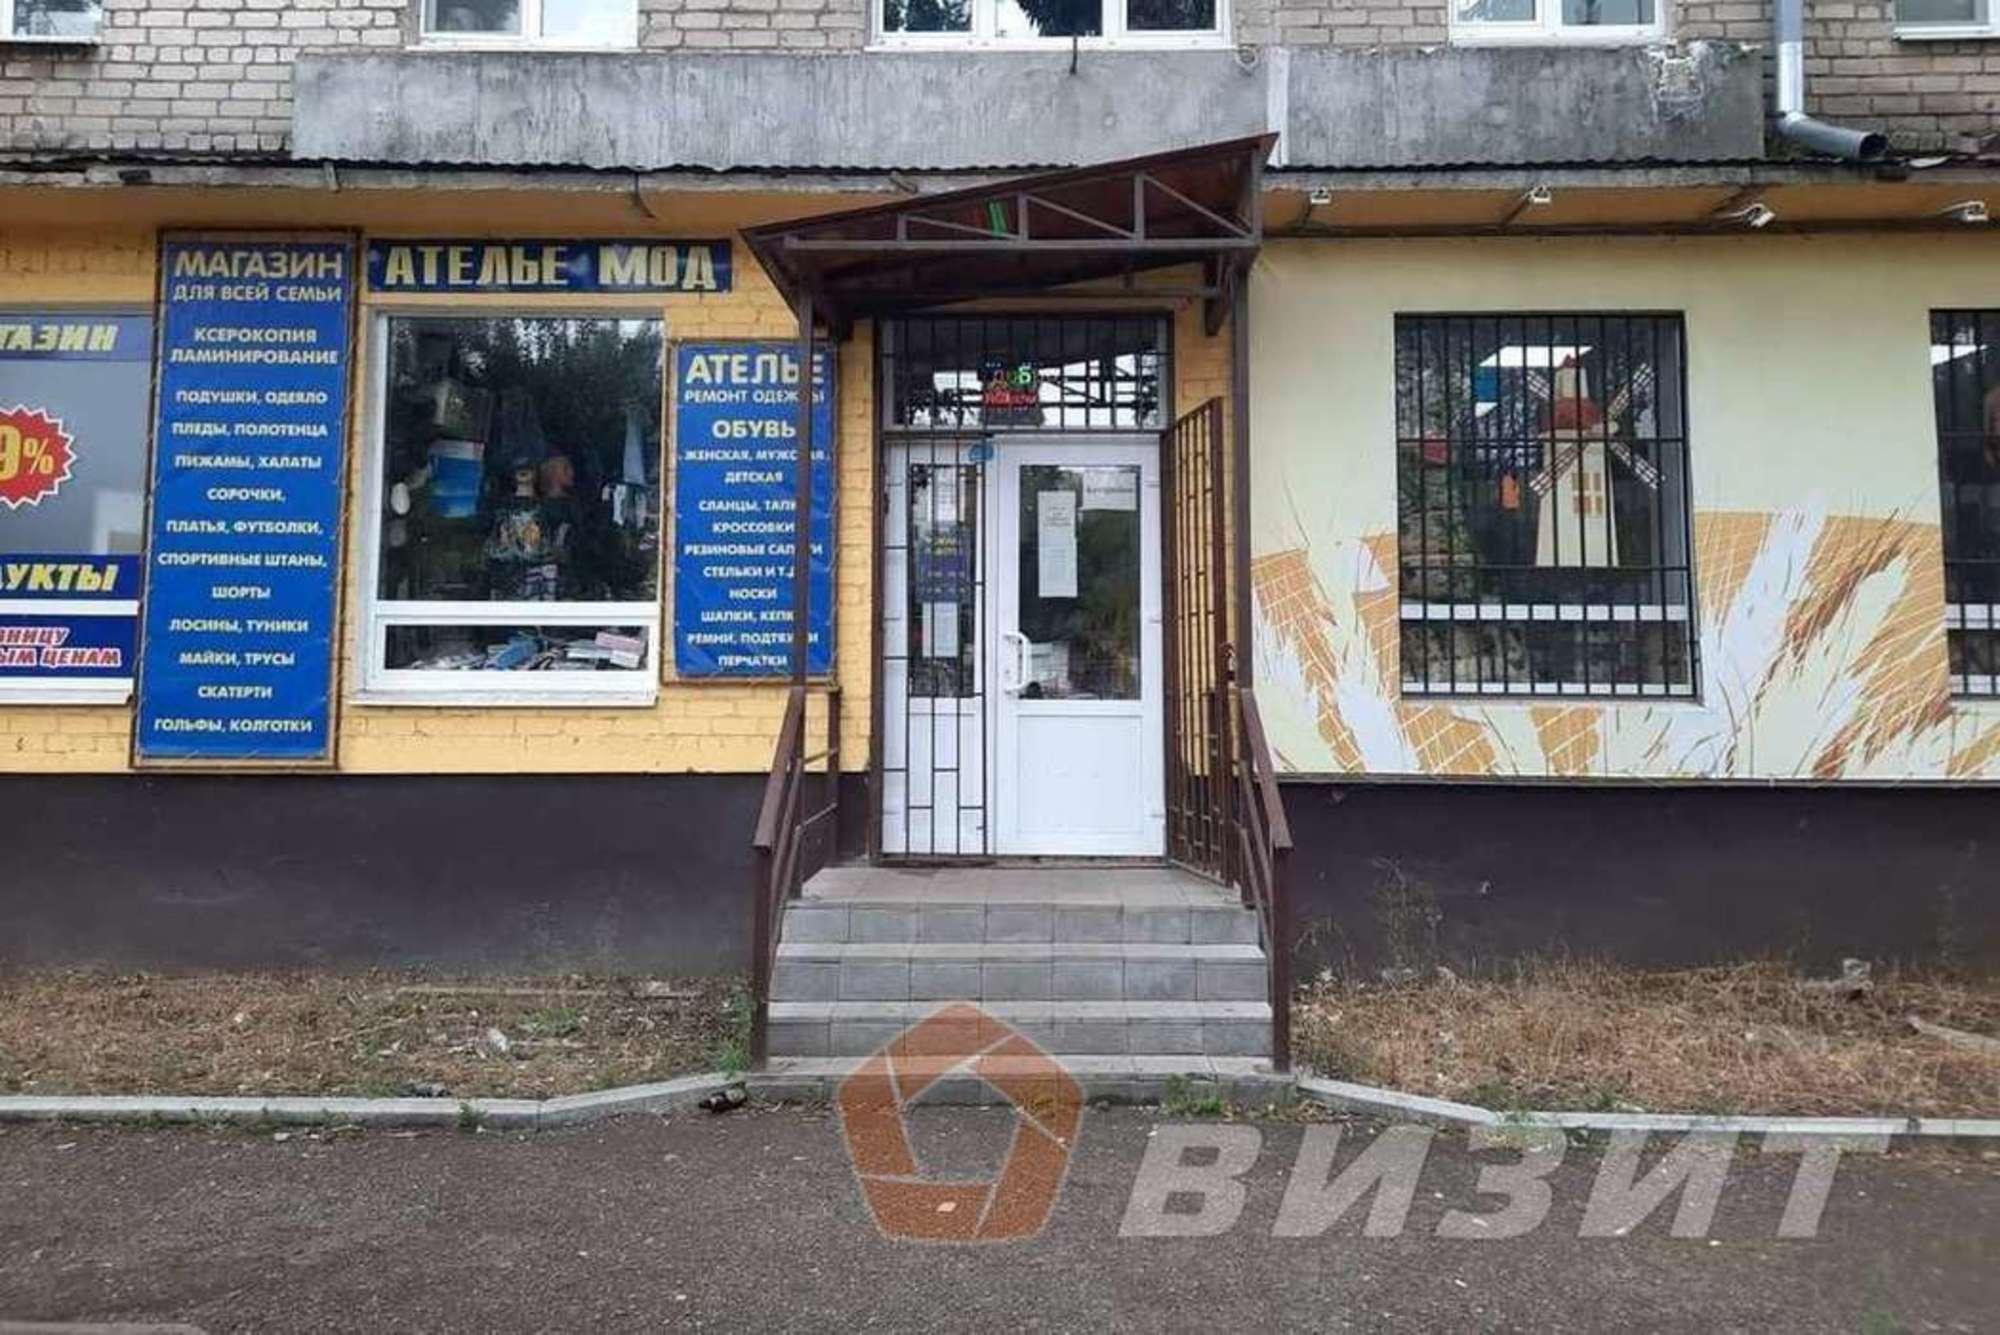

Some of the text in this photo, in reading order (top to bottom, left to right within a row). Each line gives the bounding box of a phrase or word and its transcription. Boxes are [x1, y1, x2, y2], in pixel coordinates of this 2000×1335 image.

[175, 252, 342, 279] МАГАЗИН
[385, 246, 717, 290] АТЕЛЬЕ МОД
[173, 283, 342, 303] ДЛЯ ВСЕЙ СЕМЬИ
[194, 328, 317, 343] КСЕРОКОПИЯ
[170, 349, 338, 365] ЛАМИНИРОВАНИЕ
[686, 354, 824, 384] АТЕЛЬЕ
[176, 390, 328, 405] ПОДУШКИ, ОДЕЯЛО
[684, 390, 825, 405] РЕМОНТ ОДЕЖЫ
[235, 423, 328, 437] ПОЛОТЕНЦА
[712, 420, 797, 438] ОБУВЬ
[174, 456, 322, 470] ПИЖАМЫ, ХАЛАТЫ
[724, 471, 784, 484] ДЕТСКАЯ
[207, 488, 286, 502] СОРОЧКИ,
[166, 521, 323, 535] ПЛАТЬЯ, ФУТБОЛКИ,
[684, 544, 765, 556] РЕЗИНОВЫЕ
[158, 552, 327, 568] СПОРТИВНЫЕ ШТАНЫ,
[0, 563, 119, 591] УКТЫ
[703, 566, 763, 578] СТЕЛЬКИ
[765, 566, 775, 578] И
[212, 587, 271, 599] ШОРТЫ
[729, 588, 778, 600] НОСКИ
[169, 620, 309, 634] ЛОСИНЫ, ТУНИКИ
[41, 648, 122, 668] ЦЕНАМ
[180, 652, 295, 668] МАЙКИ, ТРУСЫ
[718, 655, 788, 667] ПЕРЧАТКИ
[198, 686, 273, 698] СКАТЕРТИ
[230, 719, 313, 732] КОЛГОТКИ
